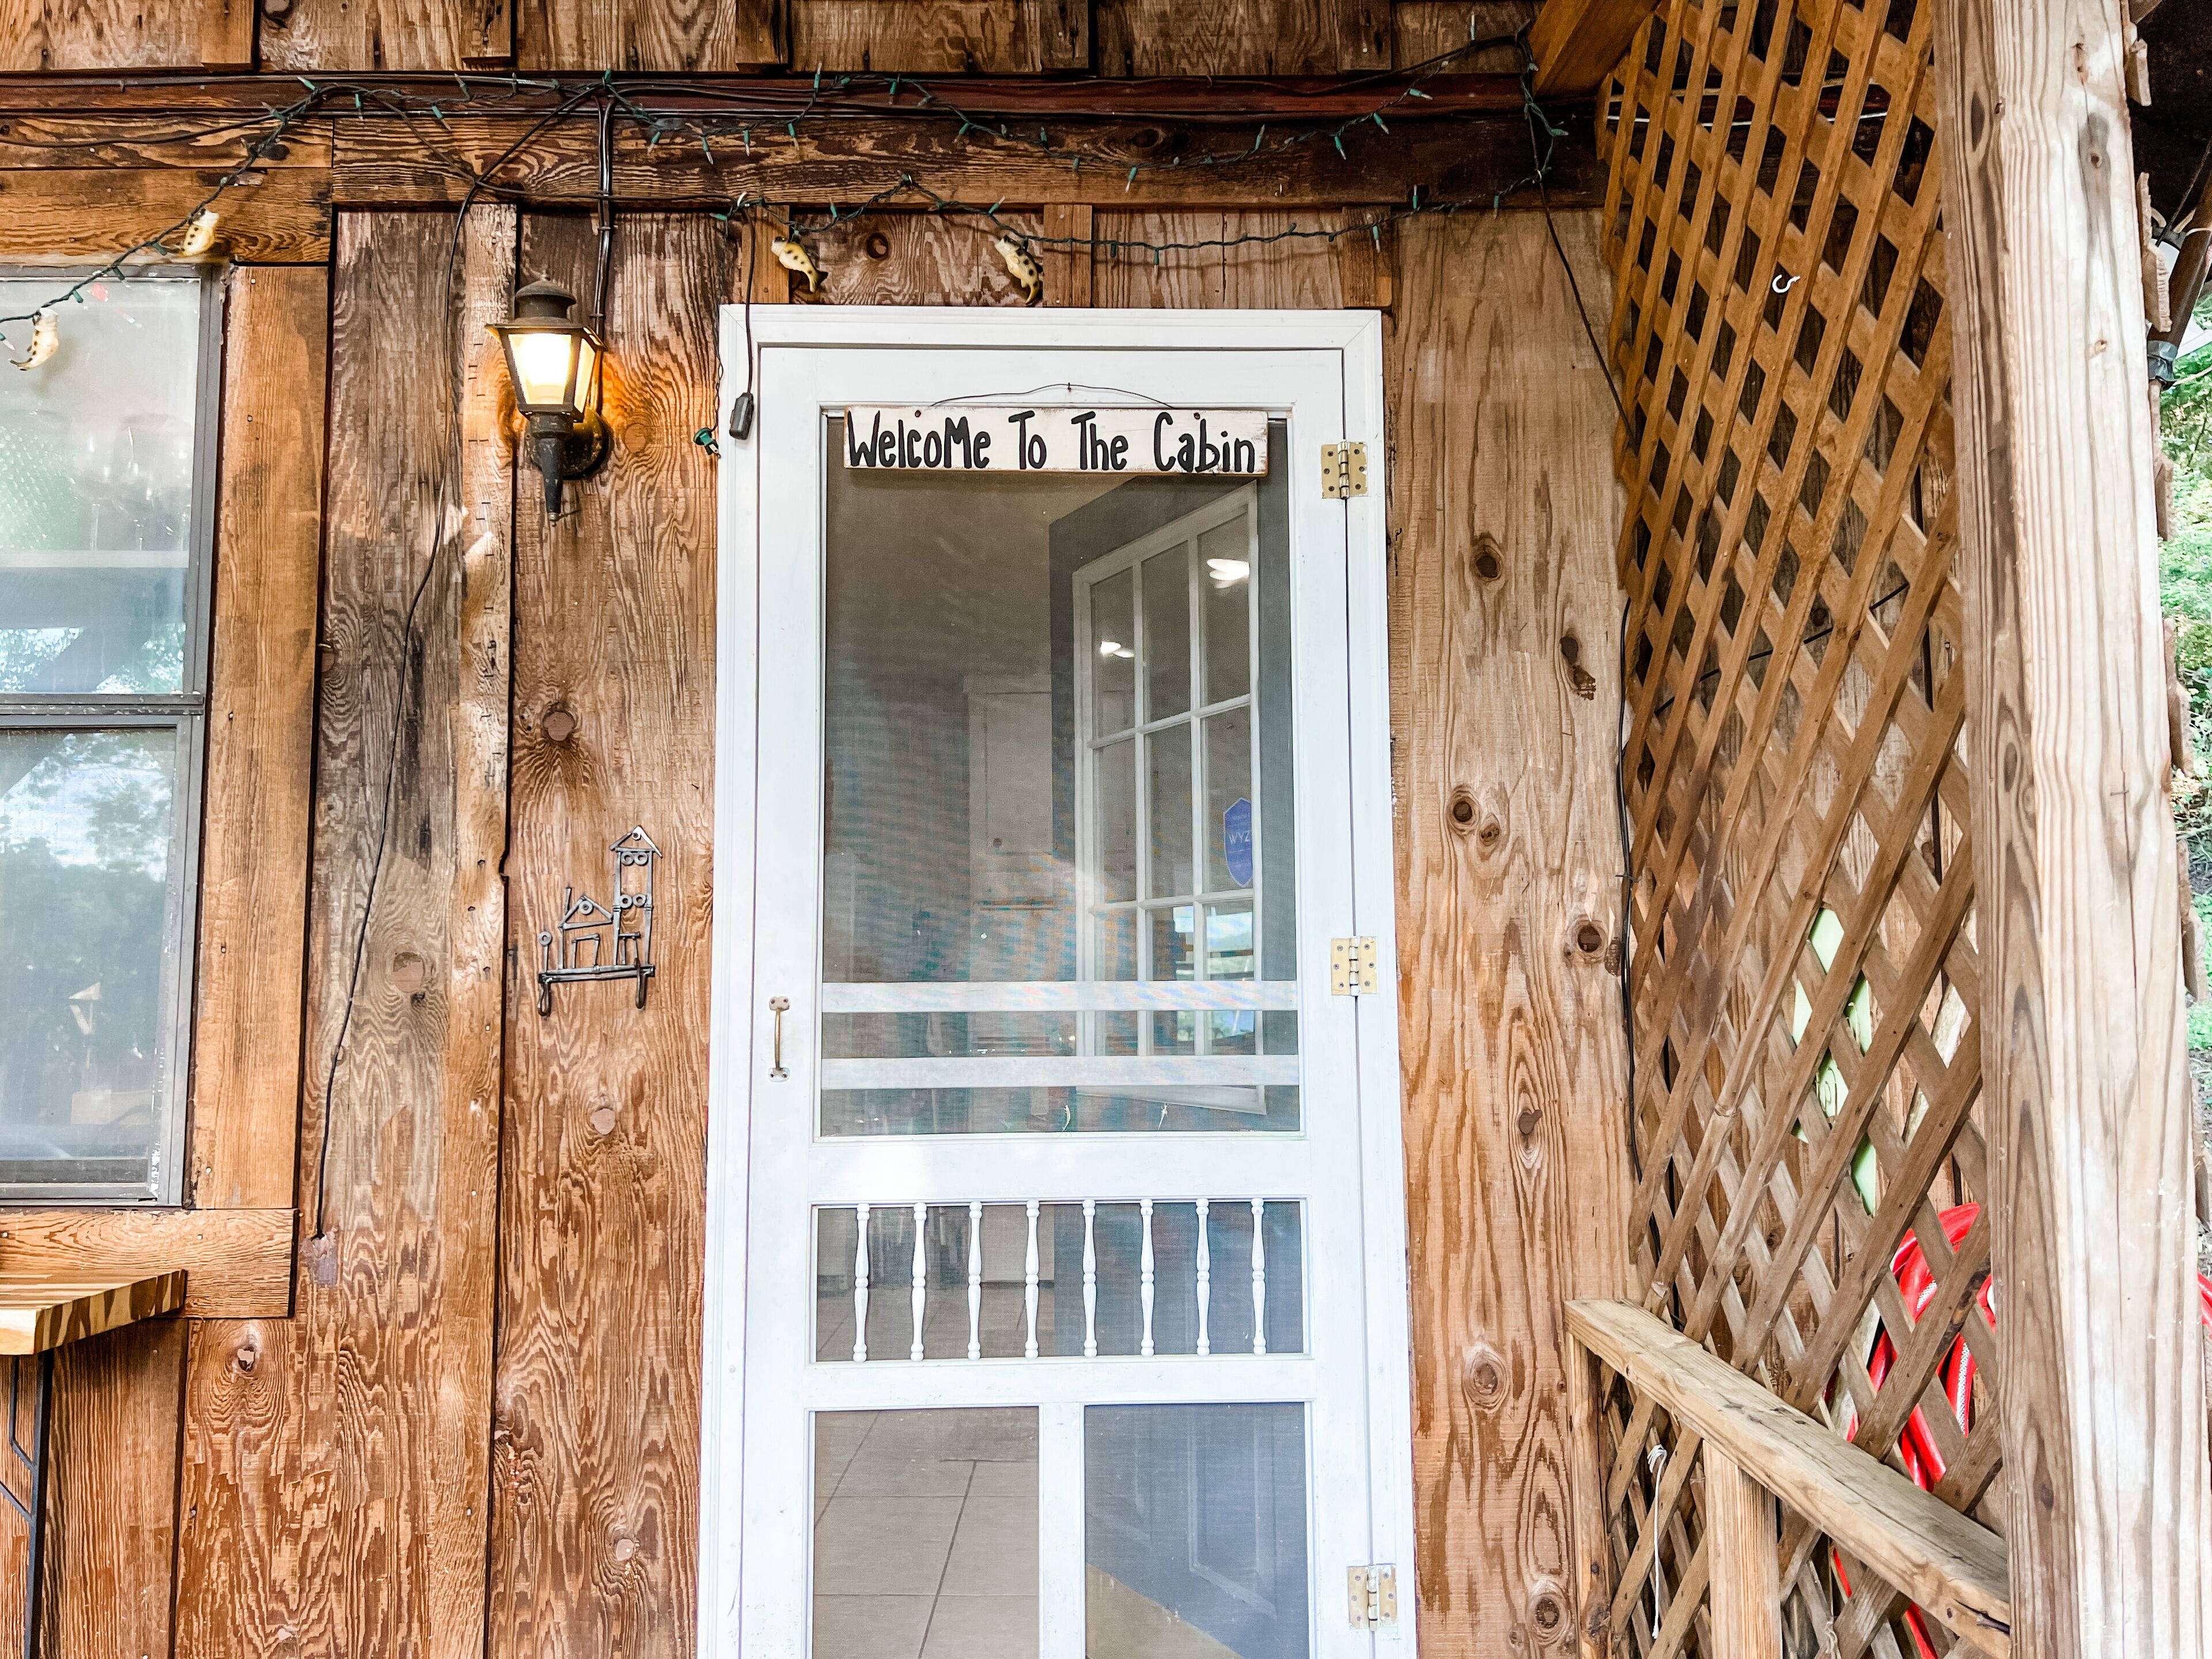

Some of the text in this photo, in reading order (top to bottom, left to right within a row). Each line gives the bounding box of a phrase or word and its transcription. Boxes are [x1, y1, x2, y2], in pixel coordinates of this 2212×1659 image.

[1008, 410, 1047, 470] To
[1071, 411, 1128, 471] The
[1153, 411, 1256, 474] Cabin
[1228, 830, 1251, 845] WYZ
